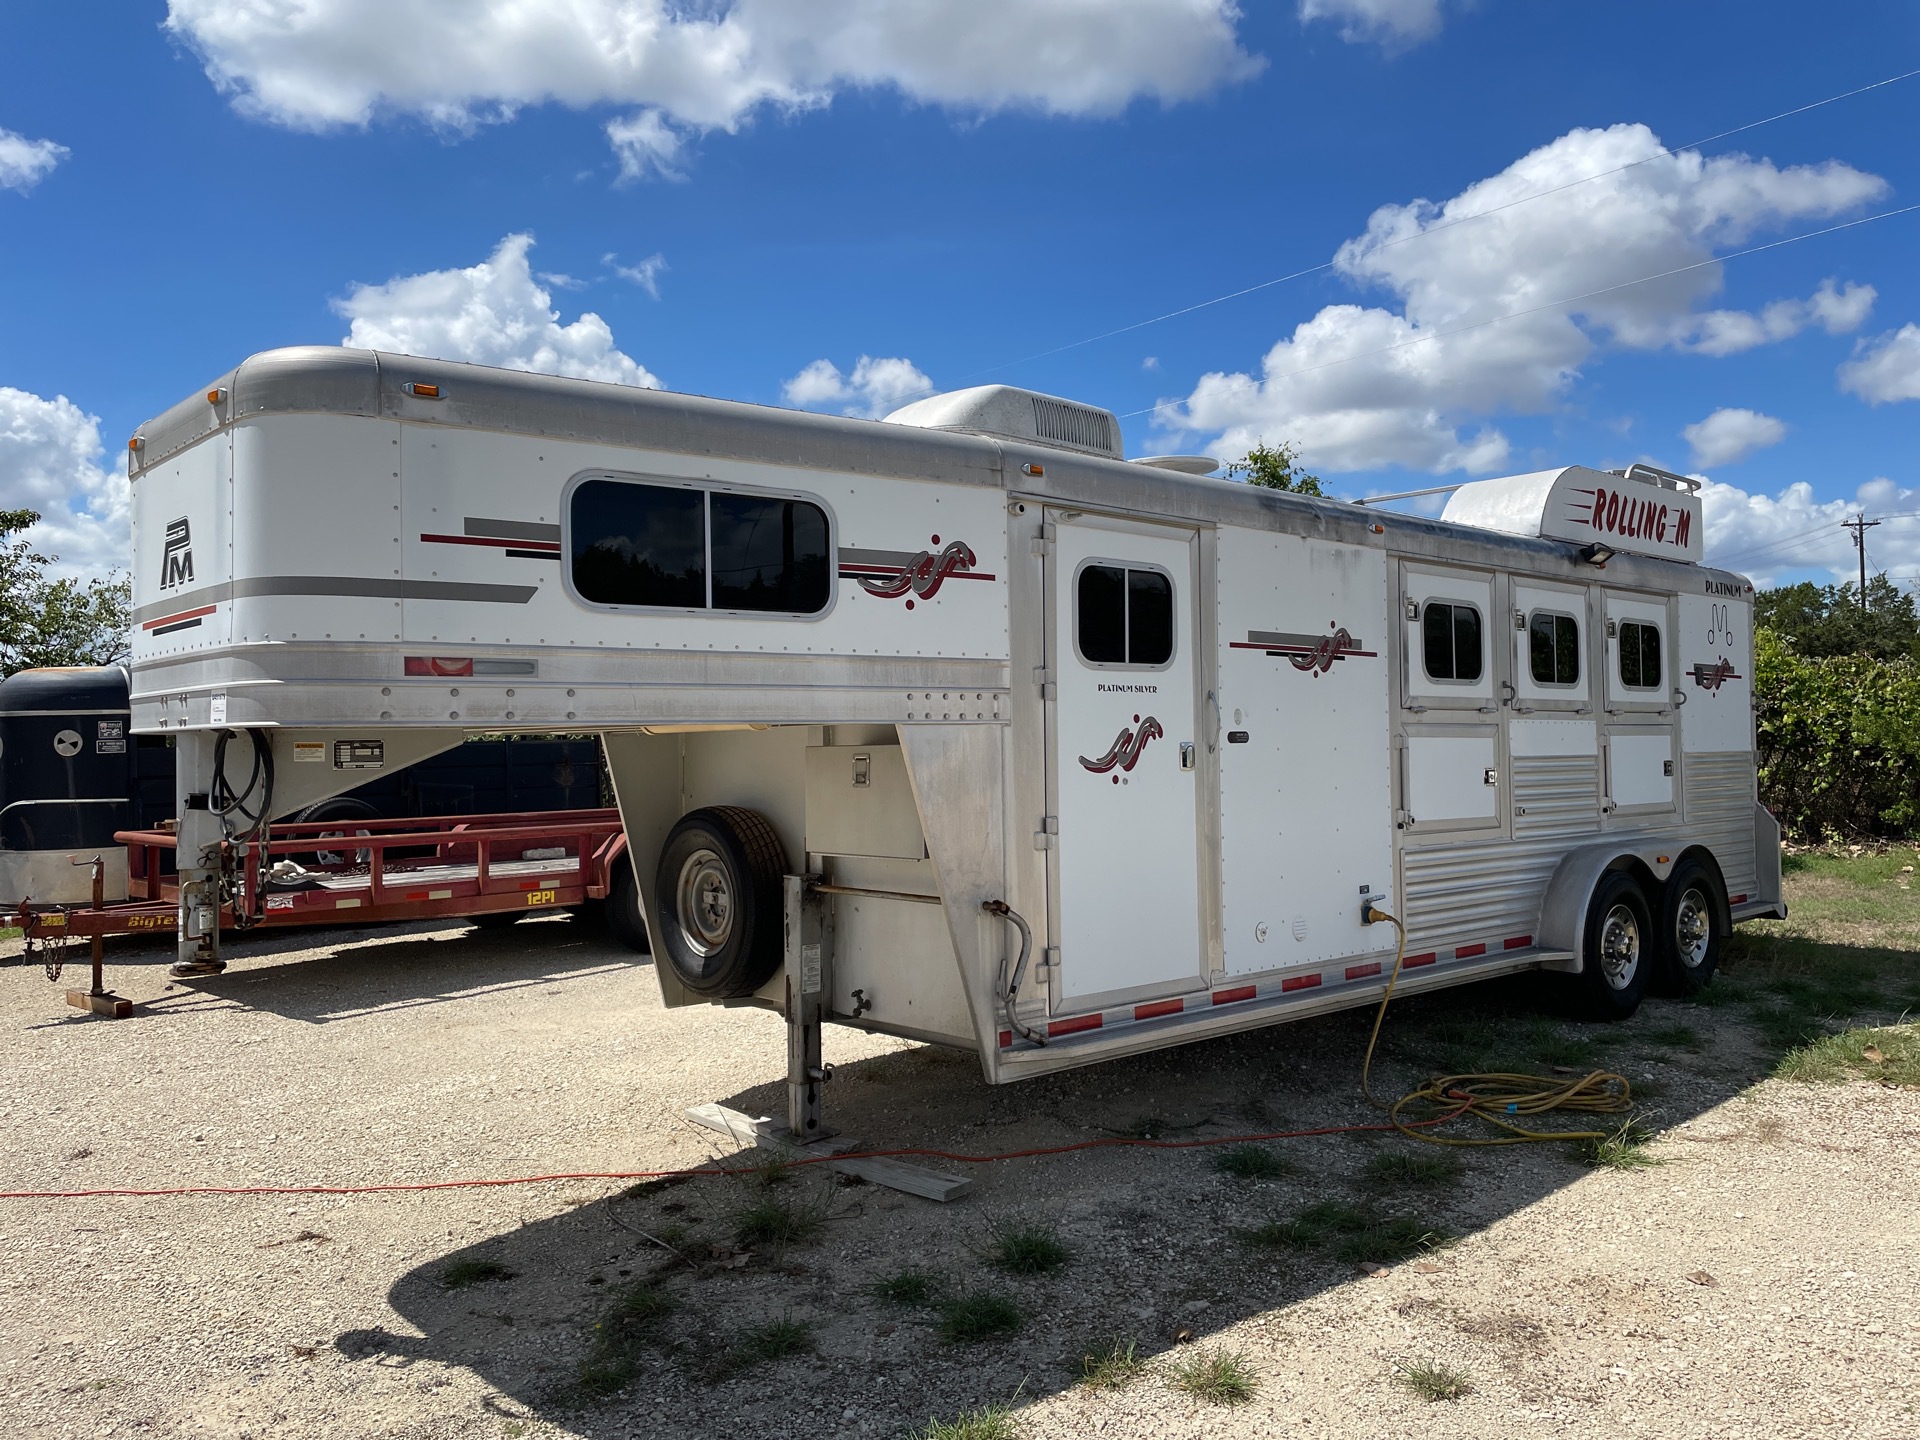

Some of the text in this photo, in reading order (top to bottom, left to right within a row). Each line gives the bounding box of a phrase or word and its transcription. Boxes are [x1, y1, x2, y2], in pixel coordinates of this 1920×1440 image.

[1592, 488, 1691, 548] ROLLING M
[1705, 580, 1741, 598] PLATINUM
[1097, 683, 1158, 694] PLATINUM SILVER
[527, 890, 555, 906] 12PI
